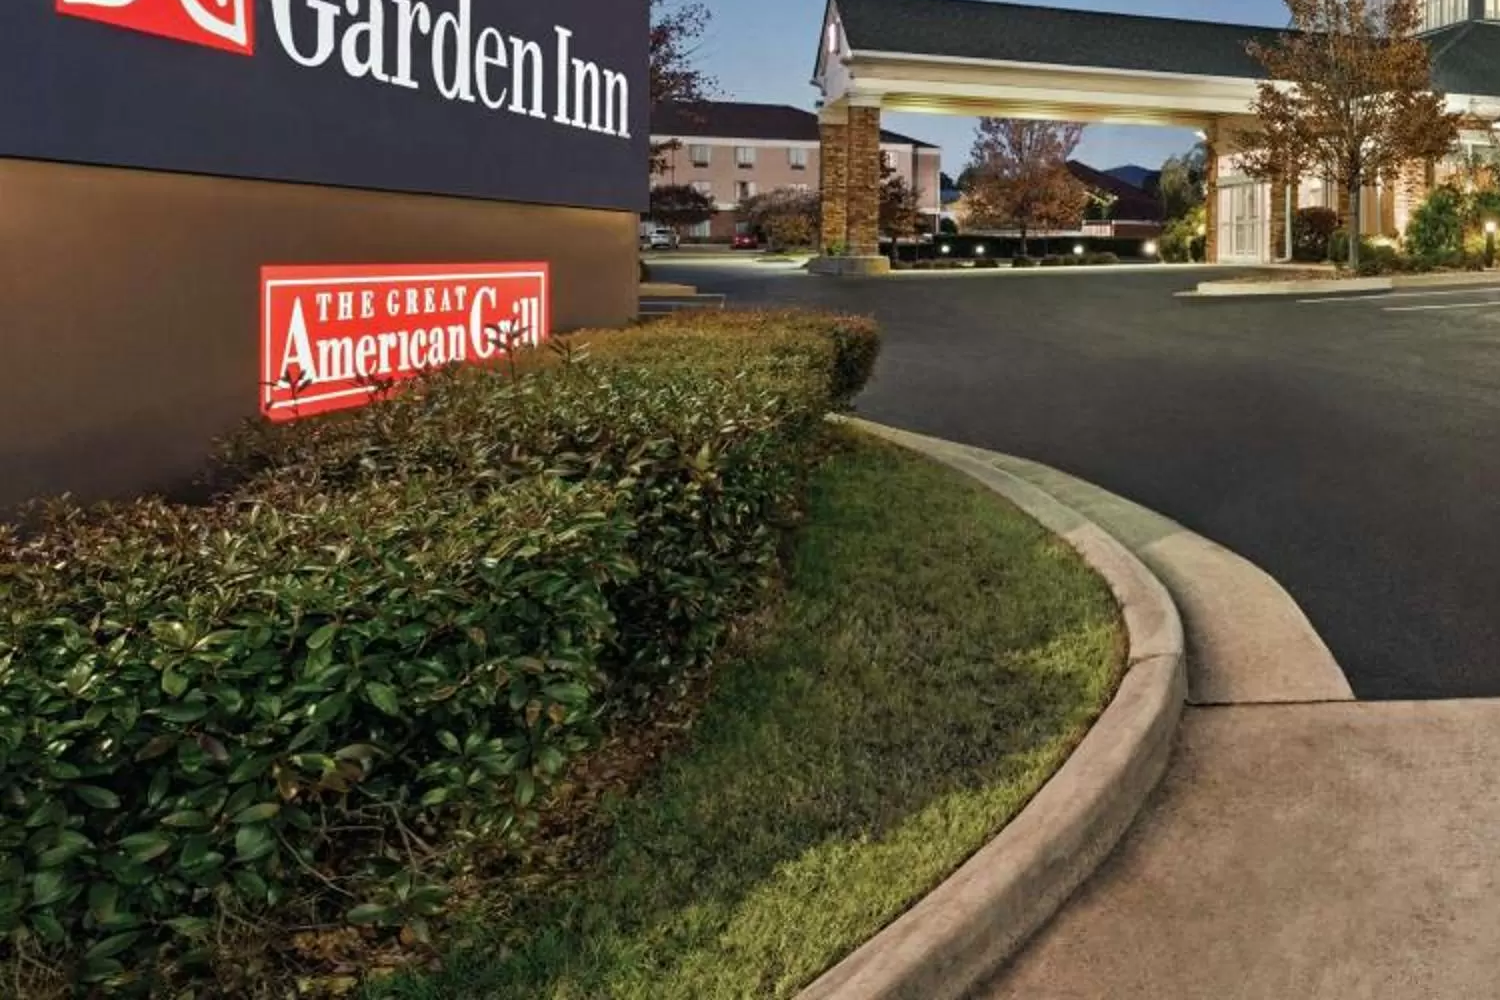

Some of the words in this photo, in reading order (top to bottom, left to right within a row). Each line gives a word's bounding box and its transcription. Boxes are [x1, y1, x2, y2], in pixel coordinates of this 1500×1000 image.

[553, 25, 632, 139] Inn
[274, 297, 466, 390] American
[316, 291, 376, 321] THE
[388, 286, 467, 314] GREAT
